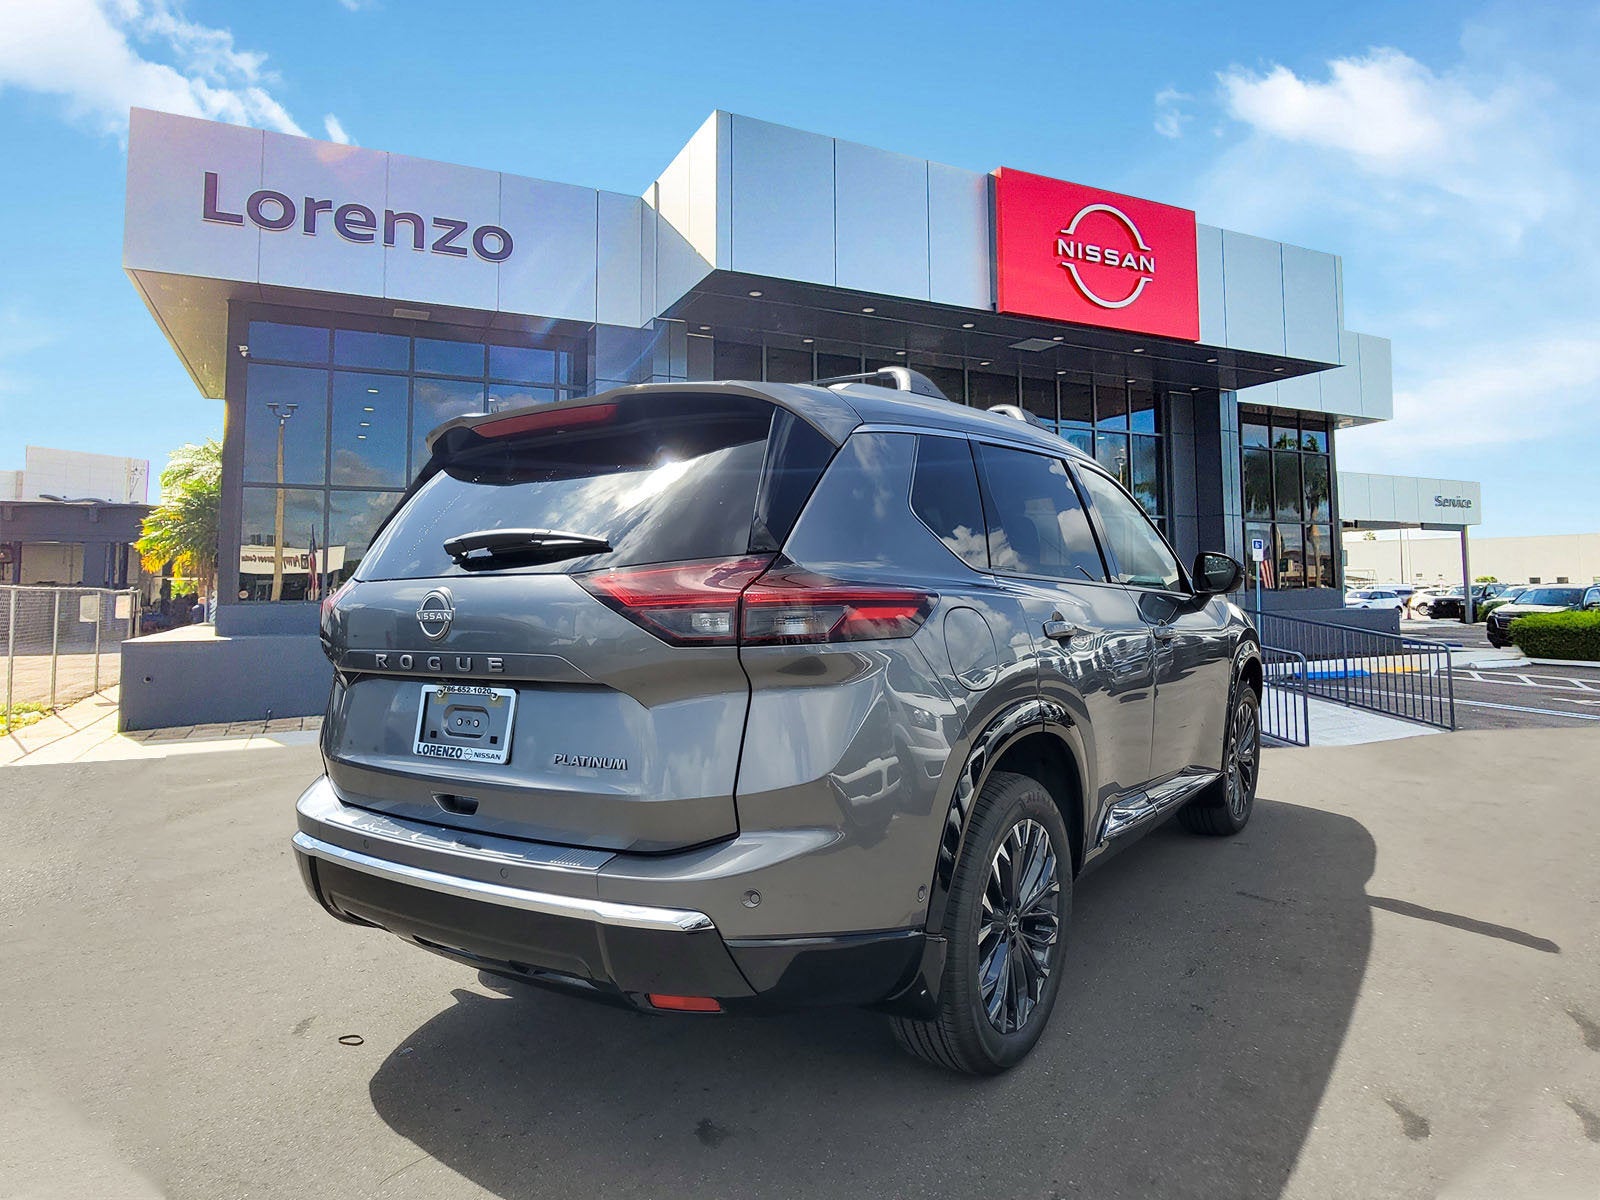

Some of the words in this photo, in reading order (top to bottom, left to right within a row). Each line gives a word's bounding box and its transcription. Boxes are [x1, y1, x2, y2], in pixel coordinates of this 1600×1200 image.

[202, 170, 515, 263] Lorenzo
[1057, 238, 1155, 273] NISSAN
[1434, 495, 1472, 509] Service
[375, 654, 505, 673] ROGUE
[442, 685, 492, 695] 786-652-1020
[416, 744, 463, 759] LORENZO
[473, 751, 502, 761] NISSAN
[553, 753, 628, 771] PLATINUM
